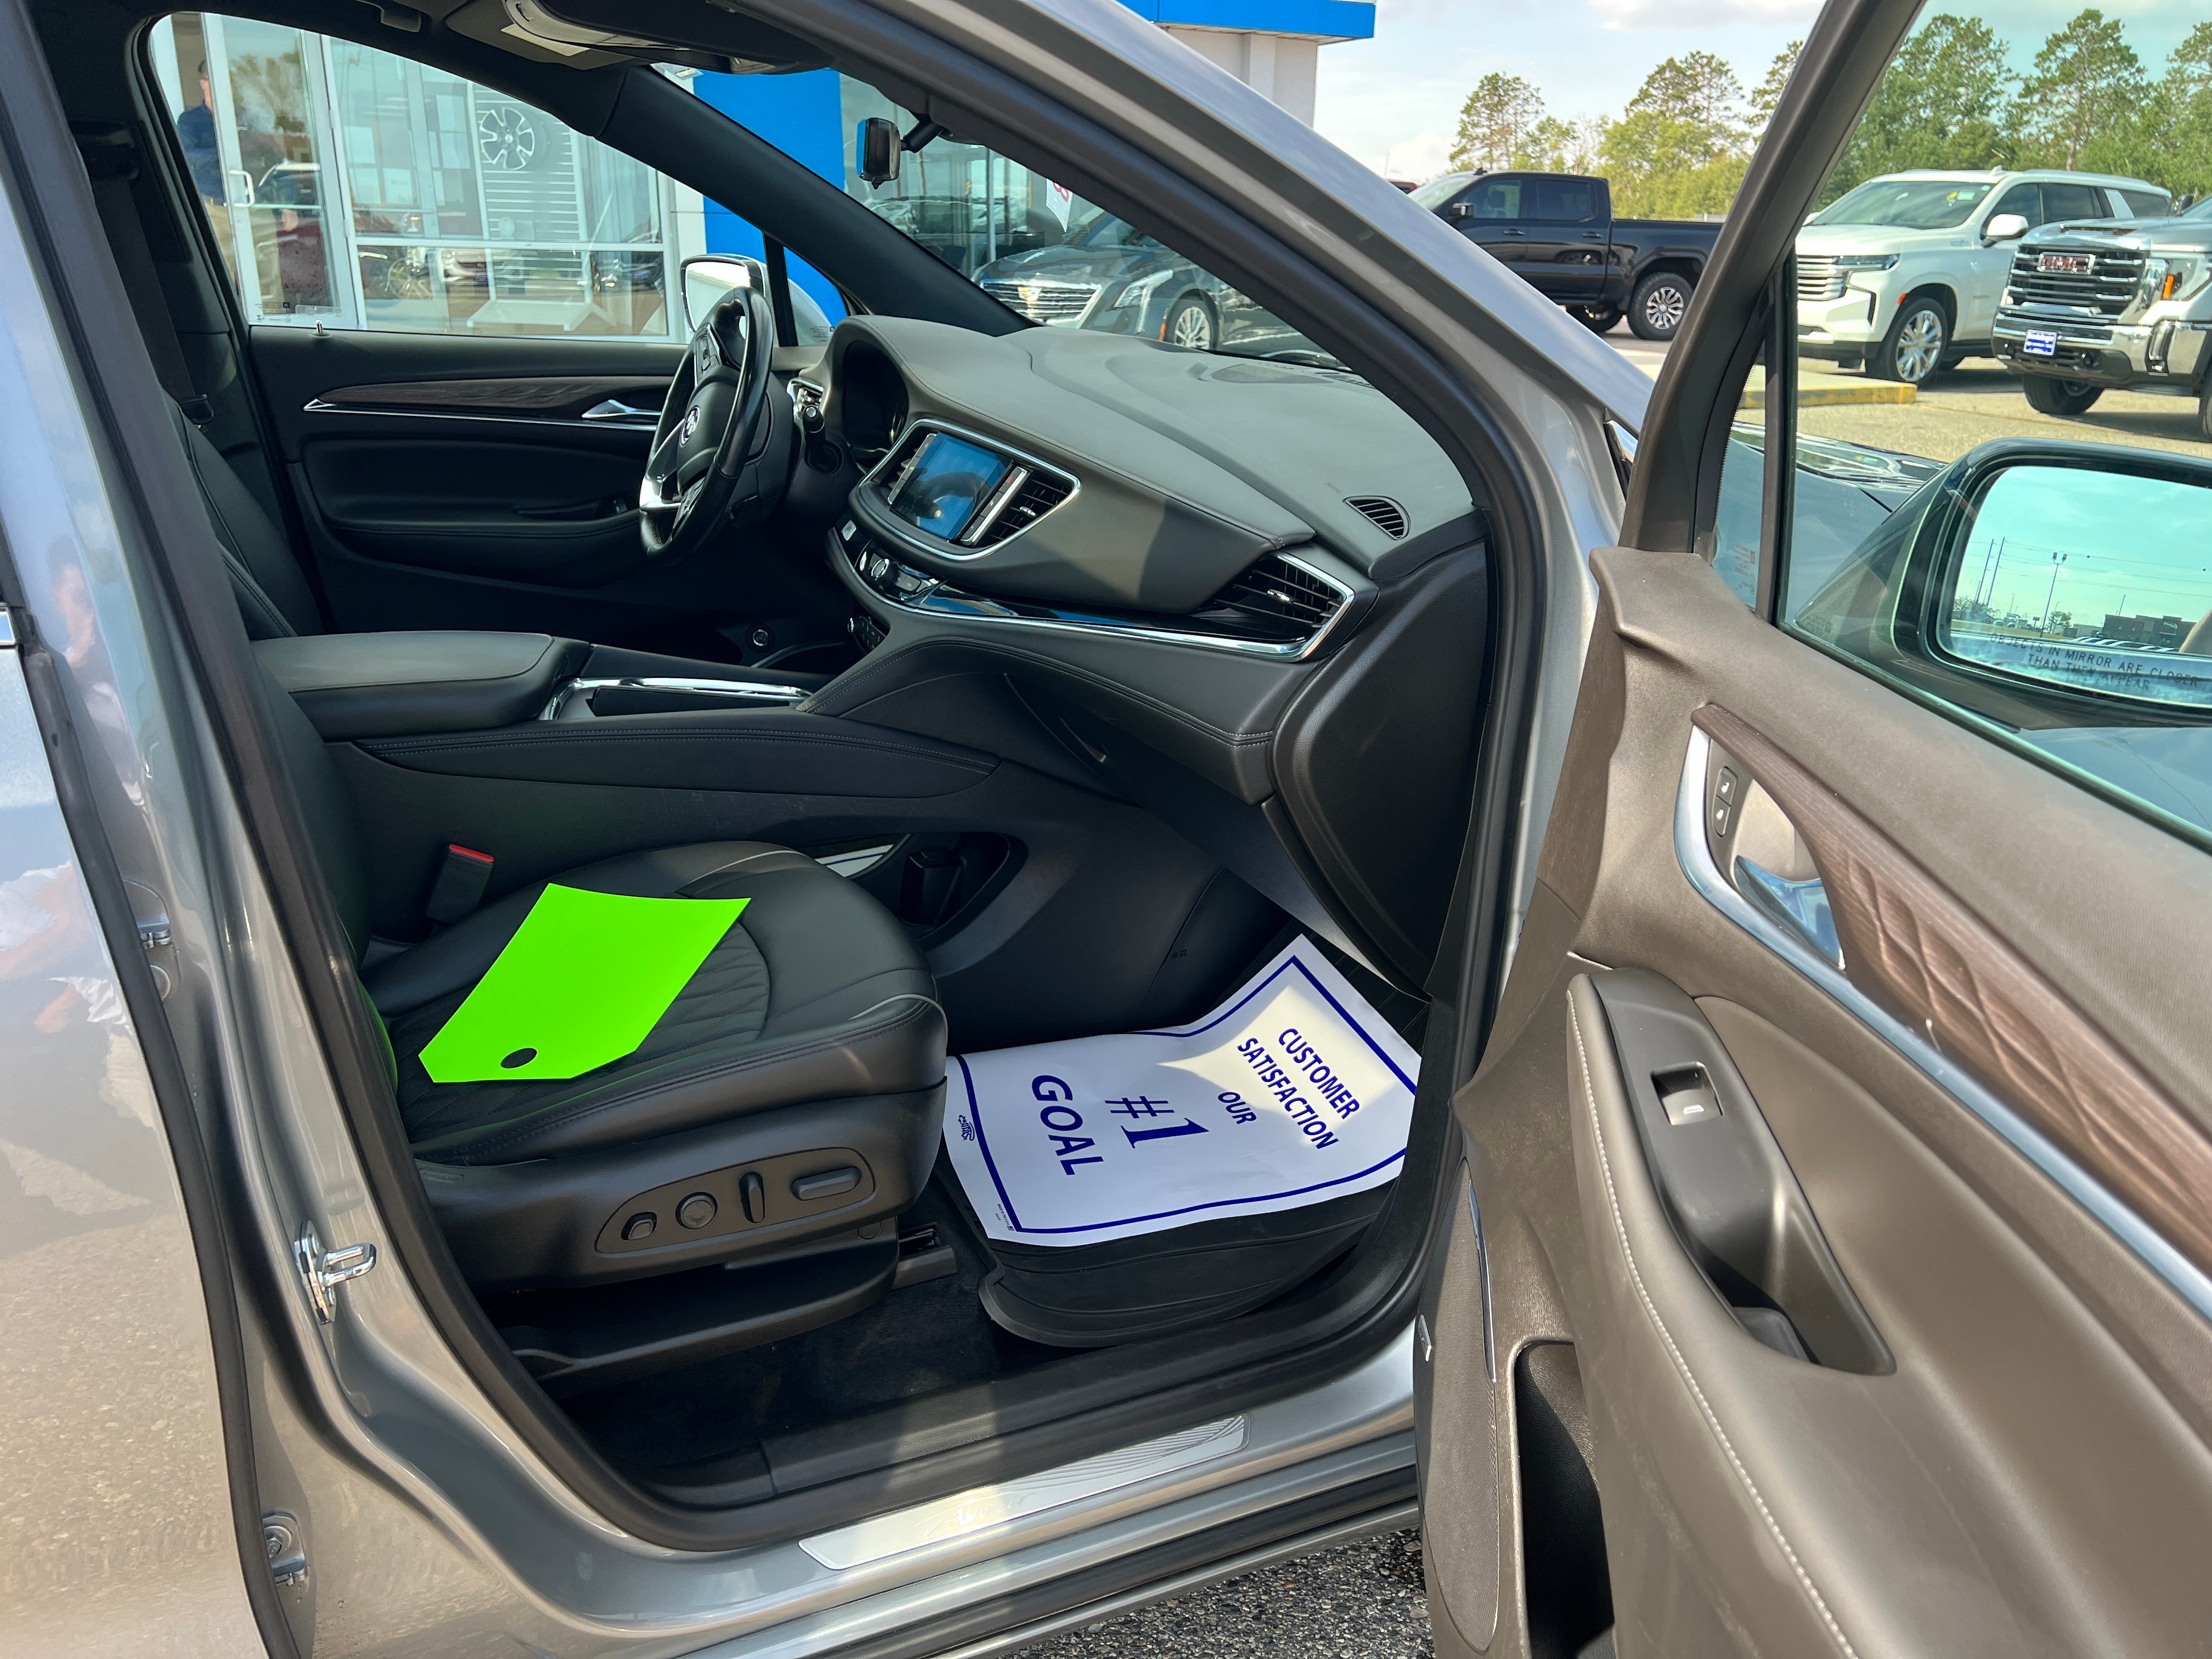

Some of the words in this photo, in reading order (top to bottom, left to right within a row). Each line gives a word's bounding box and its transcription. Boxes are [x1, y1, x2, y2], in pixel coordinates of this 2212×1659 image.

[1990, 633, 2044, 653] OBJECTS
[2049, 645, 2061, 657] IN
[2064, 650, 2112, 668] MIRROR
[2118, 661, 2143, 676] ARE
[2150, 668, 2199, 687] CLOSER
[2028, 653, 2061, 671] THAN
[2066, 662, 2097, 677] THEY
[2096, 674, 2151, 691] APPEAR
[1237, 1036, 1340, 1150] SATISFACTION
[1278, 1027, 1361, 1120] CUSTOMER
[1030, 1074, 1104, 1176] GOAL
[1104, 1094, 1210, 1149] #1
[1217, 1091, 1257, 1125] OUR
